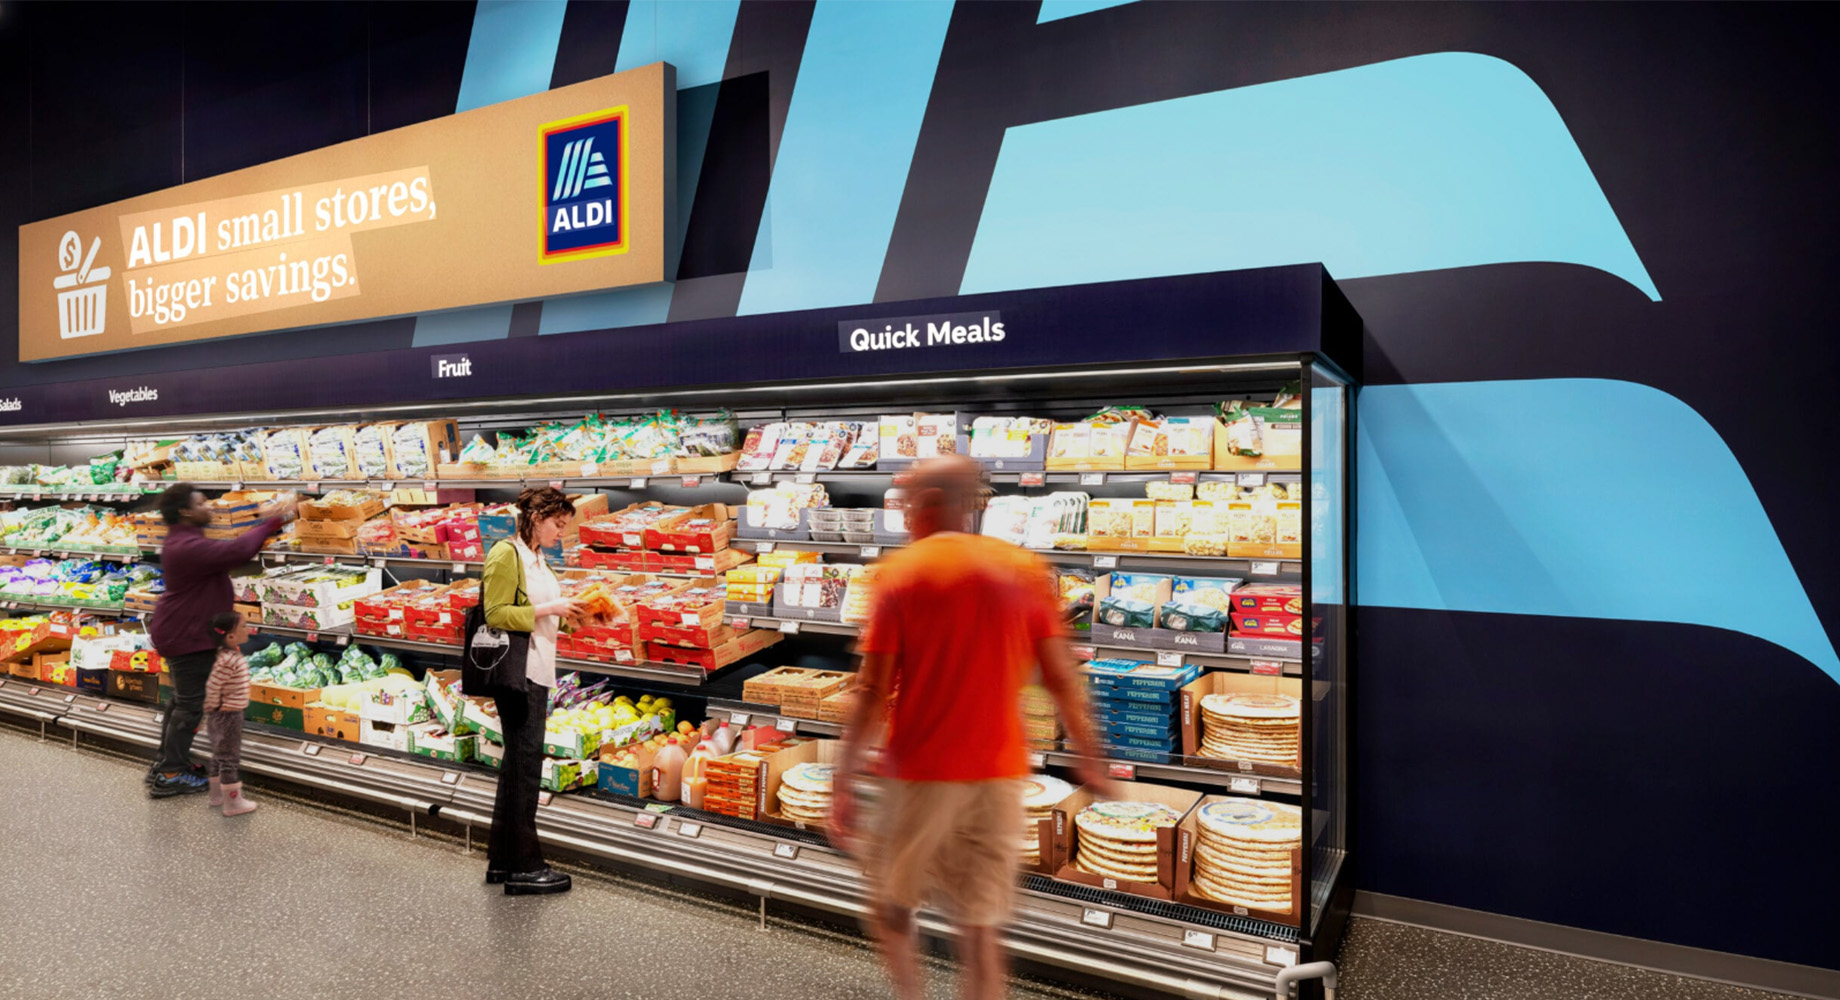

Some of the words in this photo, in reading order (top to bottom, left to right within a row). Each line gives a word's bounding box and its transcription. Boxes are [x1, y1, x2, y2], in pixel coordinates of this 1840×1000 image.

[128, 212, 206, 268] ALDI
[217, 191, 305, 250] small
[315, 175, 437, 232] stores,
[552, 199, 612, 233] ALDI
[129, 274, 217, 325] bigger
[226, 252, 356, 302] savings.
[850, 323, 921, 351] Quick
[927, 316, 1006, 346] Meals
[438, 357, 472, 378] Fruit
[108, 386, 158, 407] Vegetables
